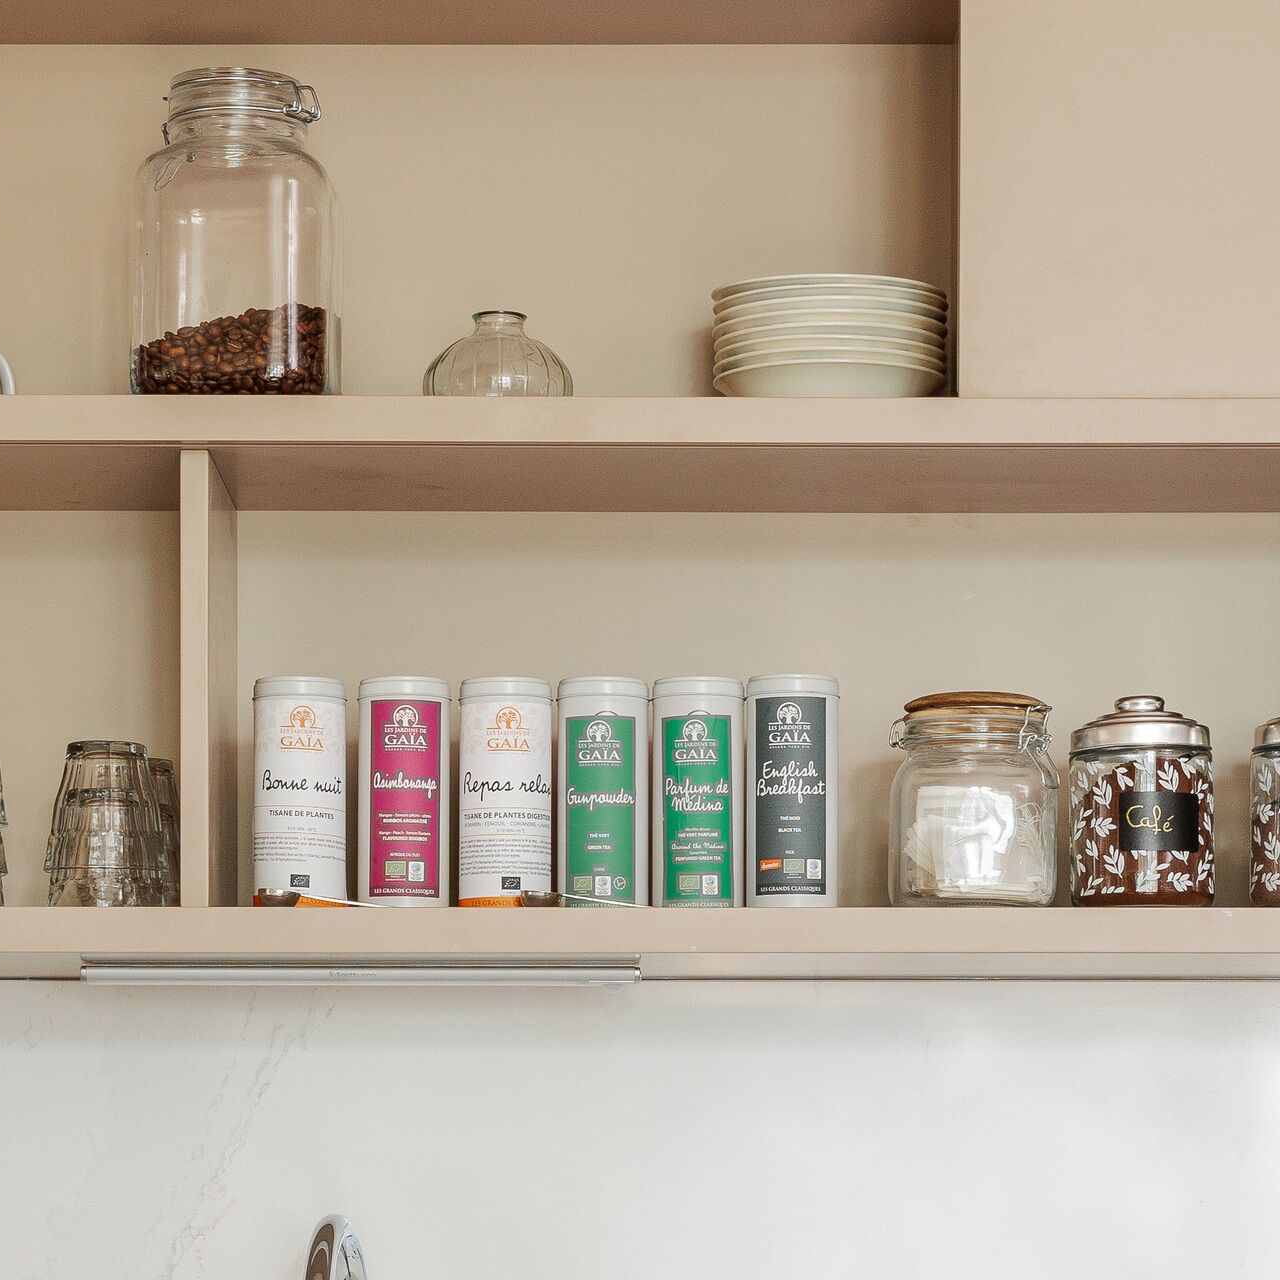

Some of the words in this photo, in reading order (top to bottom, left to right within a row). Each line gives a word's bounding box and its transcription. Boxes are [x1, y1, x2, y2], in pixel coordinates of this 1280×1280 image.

[280, 735, 323, 748] GAÏA
[384, 732, 427, 746] GAÏA
[487, 736, 530, 749] GAÏA
[768, 730, 812, 743] GAÏA
[578, 747, 621, 760] GAÏA
[675, 746, 717, 759] GAÏA
[762, 760, 819, 786] English
[262, 769, 309, 791] Bonne
[314, 776, 342, 794] nuit
[463, 771, 514, 802] Repas
[665, 777, 713, 802] Parfum
[716, 777, 729, 794] de
[567, 787, 635, 810] Gunpowder
[757, 778, 825, 804] Breakfast
[671, 794, 724, 812] Médina
[269, 809, 293, 817] TISANE
[306, 811, 335, 820] PLANTES
[494, 811, 526, 819] PLANTES
[1126, 805, 1174, 835] Café
